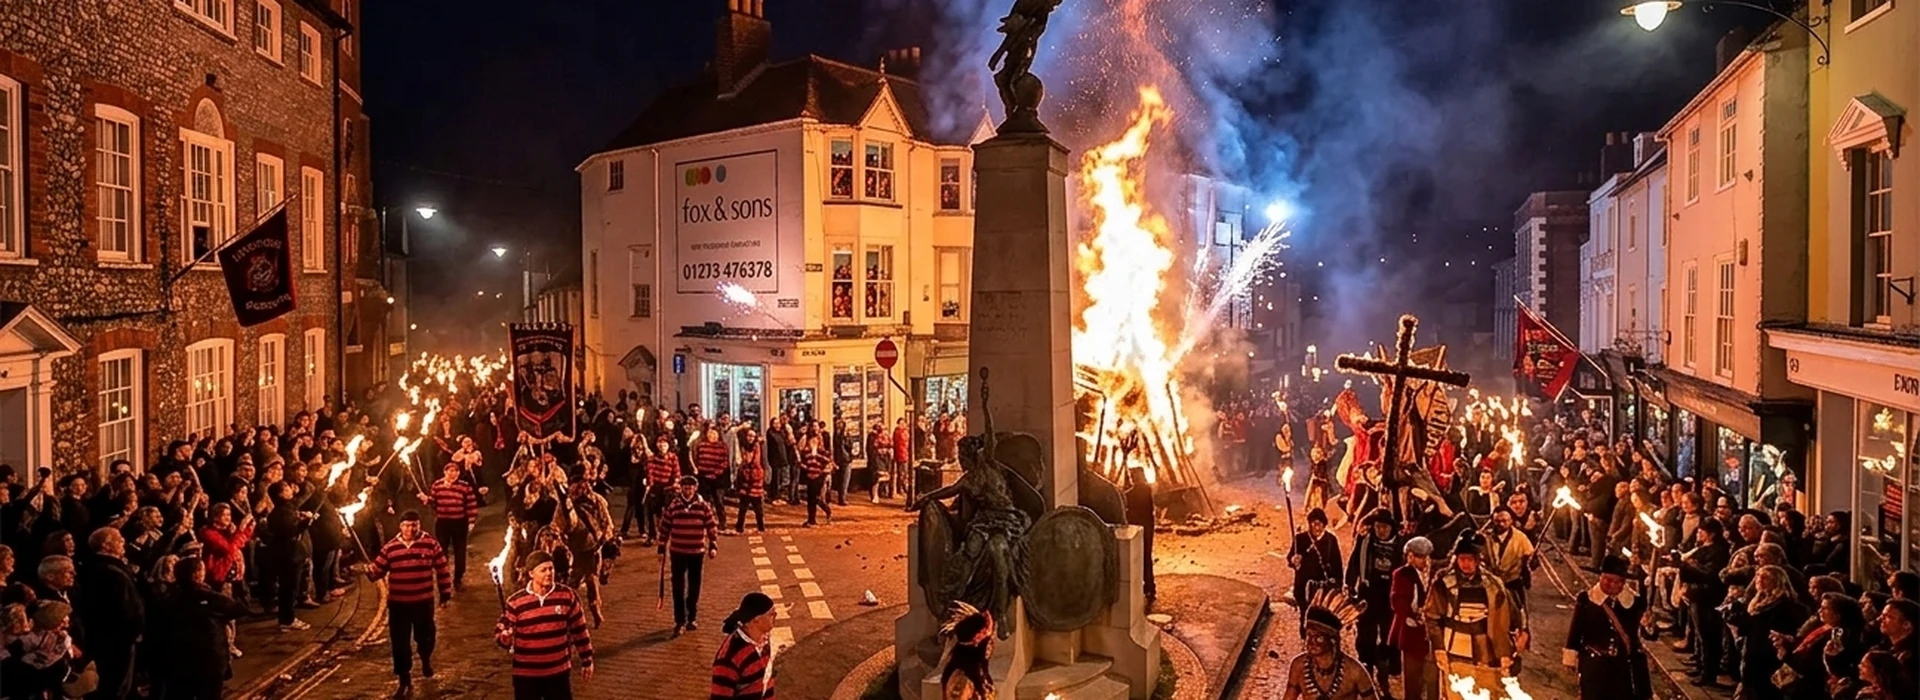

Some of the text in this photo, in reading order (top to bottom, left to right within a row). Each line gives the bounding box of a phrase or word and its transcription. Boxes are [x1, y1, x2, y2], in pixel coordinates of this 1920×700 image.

[682, 195, 772, 223] fox & sons
[723, 260, 772, 278] 476378
